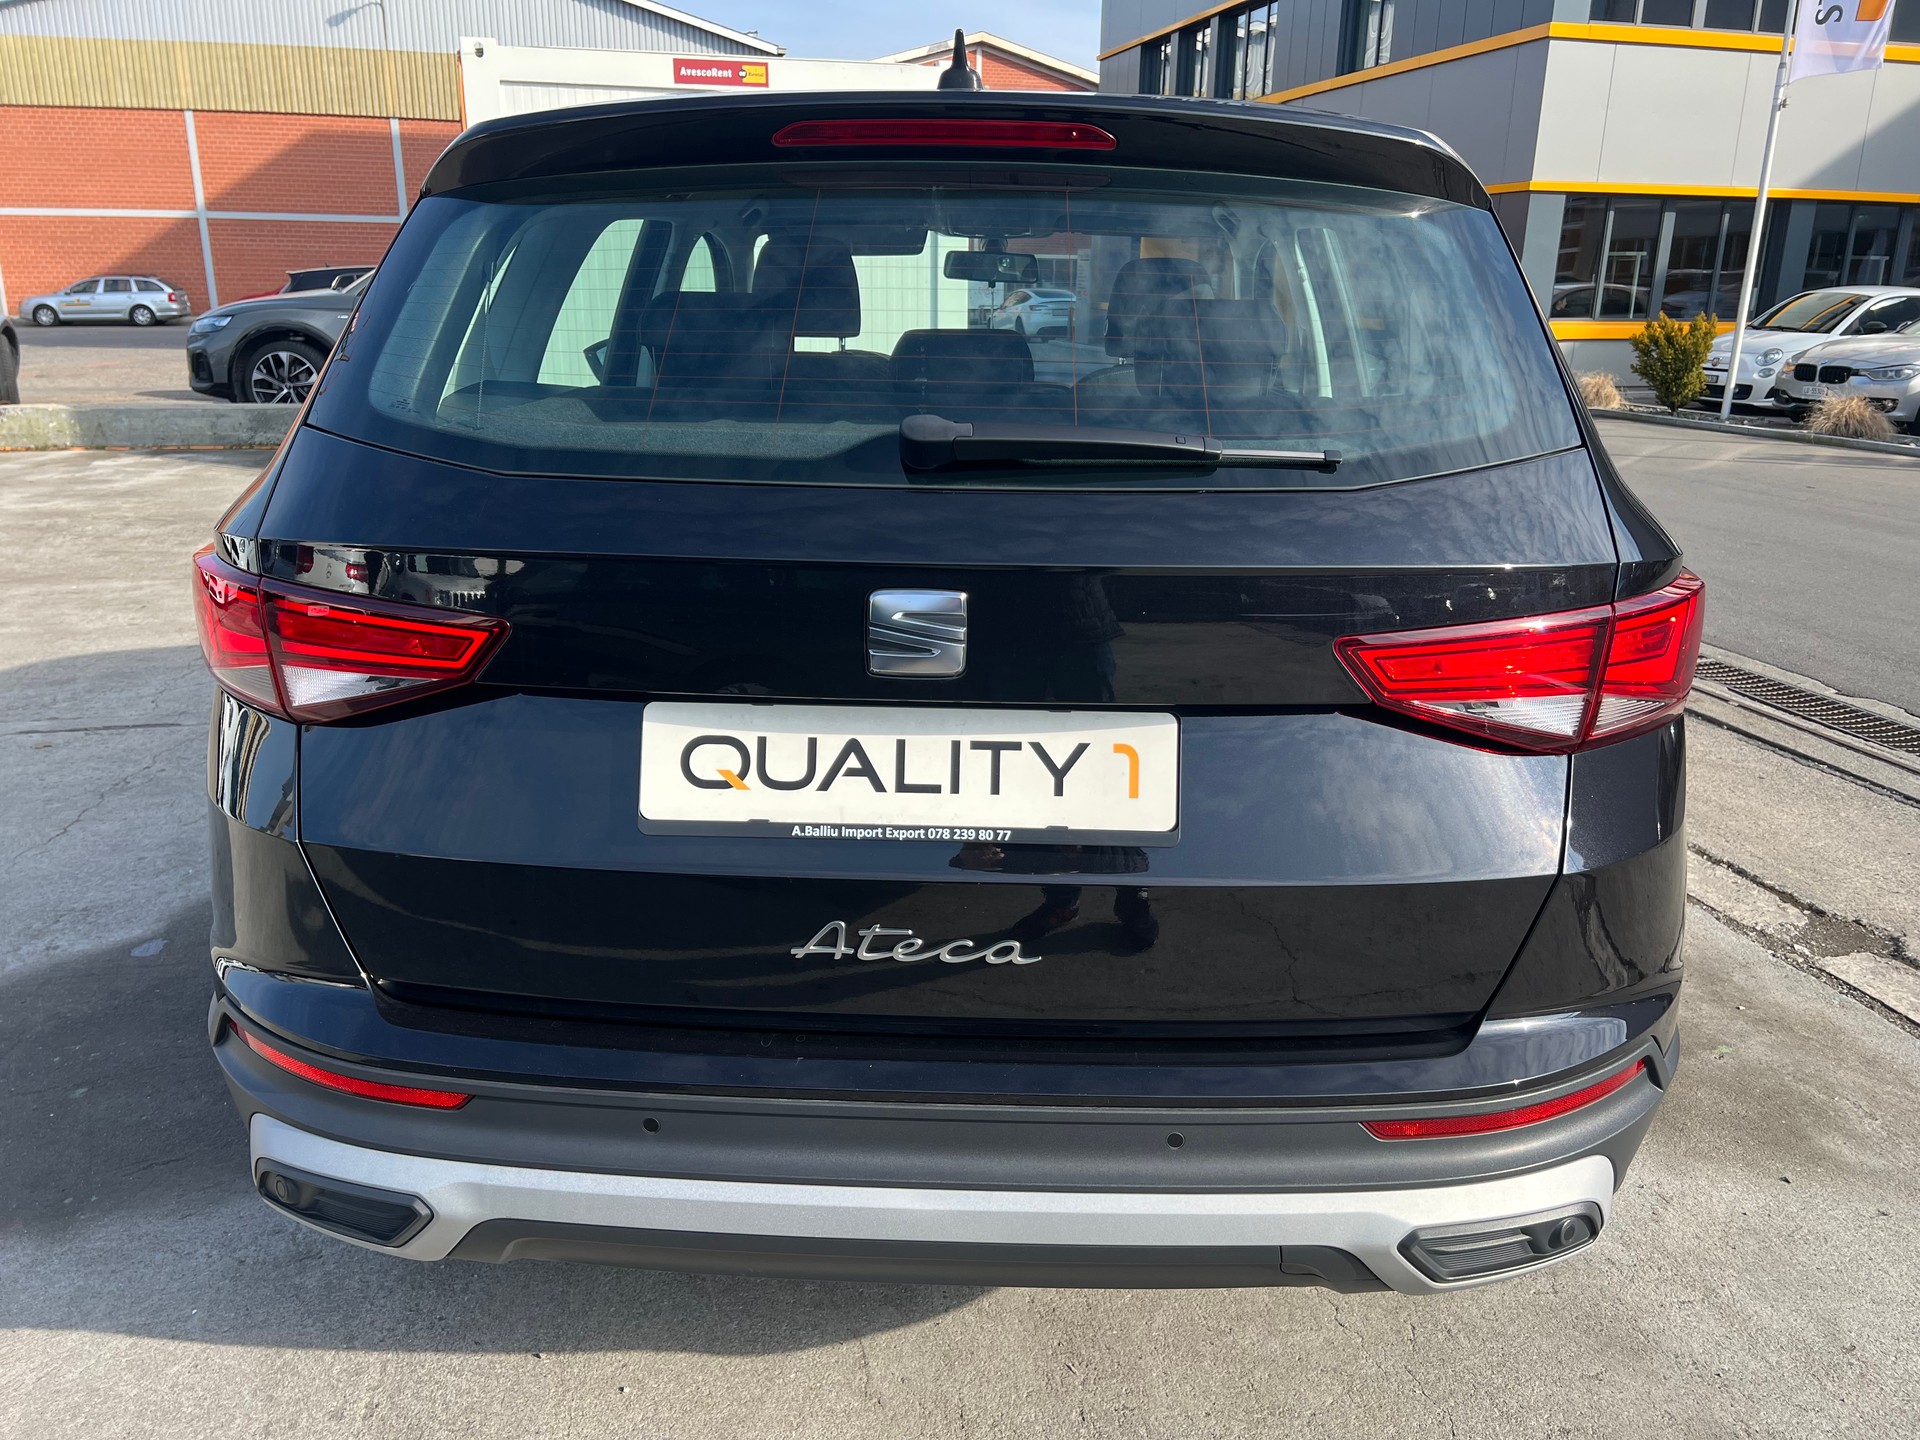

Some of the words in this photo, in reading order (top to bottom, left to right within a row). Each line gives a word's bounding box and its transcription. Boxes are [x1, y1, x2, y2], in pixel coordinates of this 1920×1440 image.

[680, 66, 732, 78] AvescoRent
[680, 734, 1090, 797] QUALITY
[1113, 743, 1139, 799] 1
[791, 825, 838, 838] A.Balliu
[842, 826, 883, 840] Import
[886, 827, 925, 841] Export
[928, 828, 951, 839] 078
[953, 829, 975, 840] 239
[978, 829, 994, 841] 80
[996, 830, 1012, 842] 77
[790, 920, 1042, 965] Ateca
